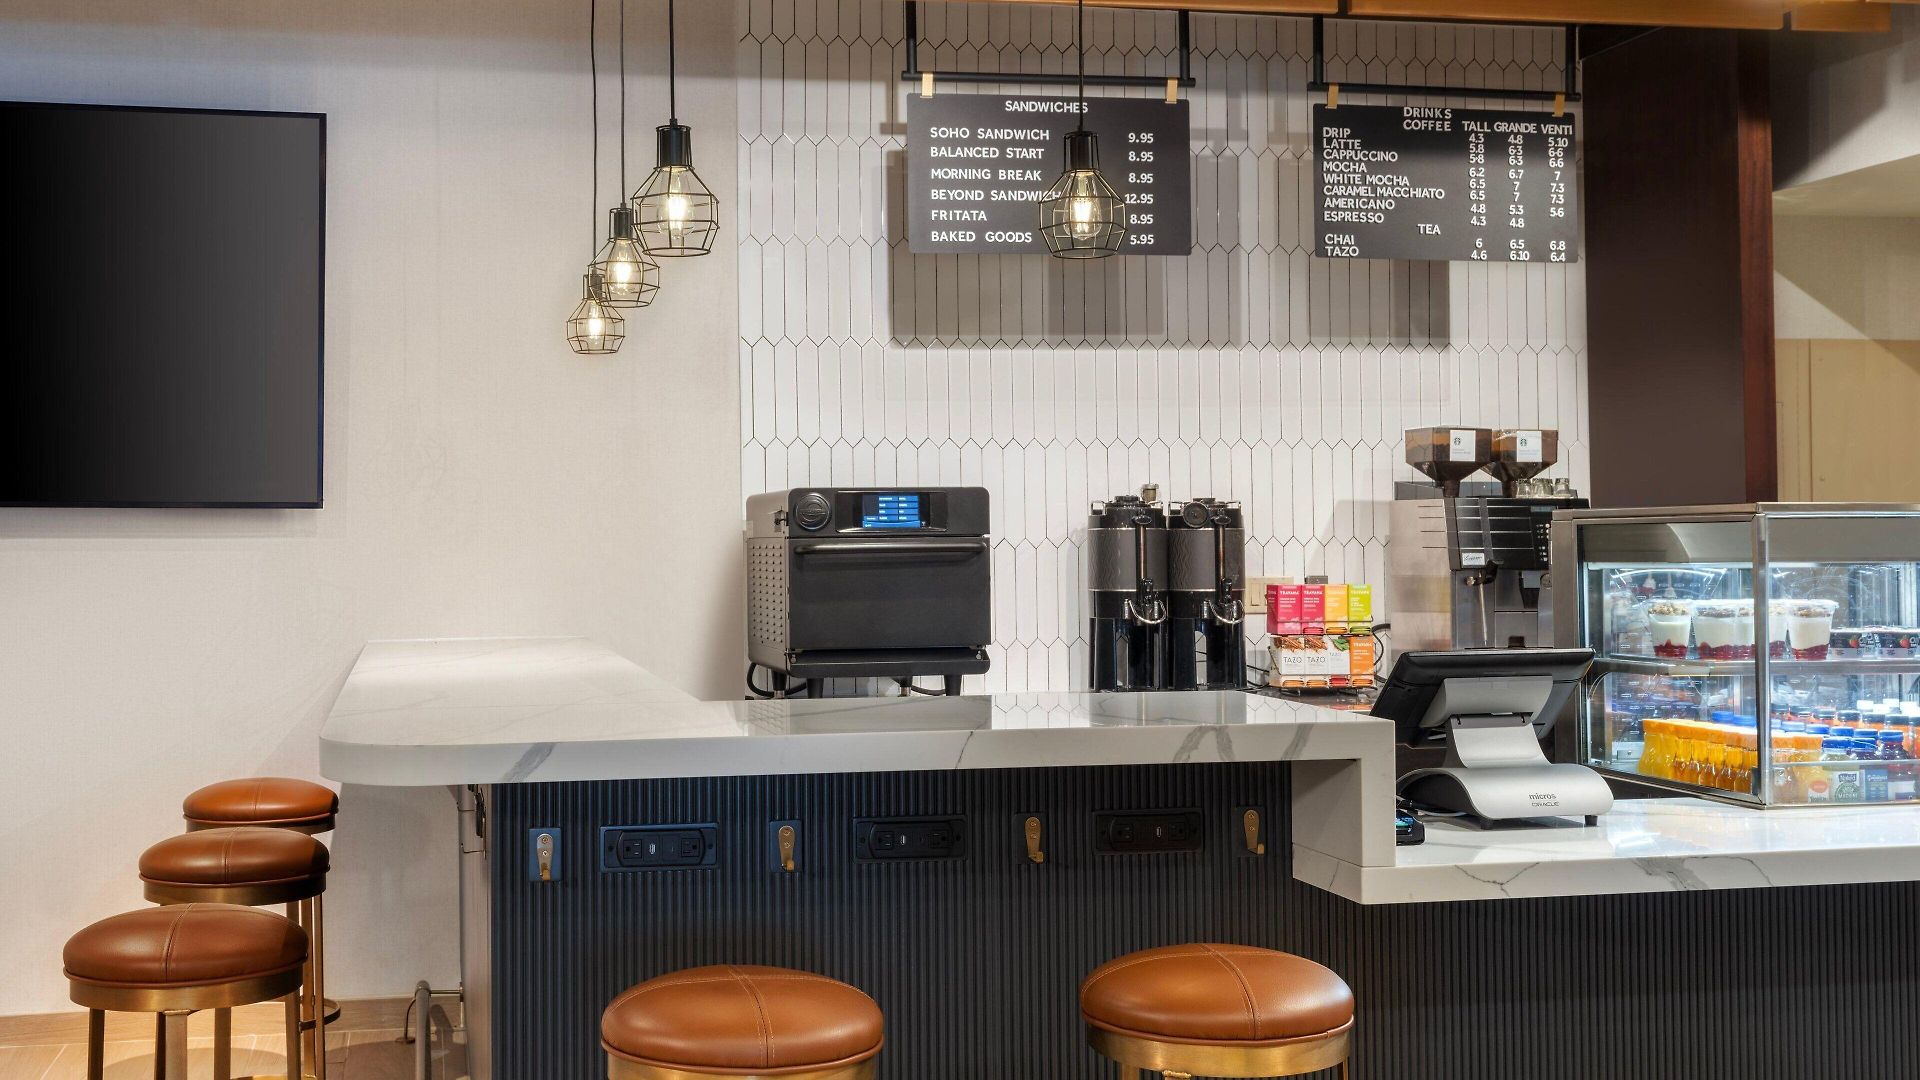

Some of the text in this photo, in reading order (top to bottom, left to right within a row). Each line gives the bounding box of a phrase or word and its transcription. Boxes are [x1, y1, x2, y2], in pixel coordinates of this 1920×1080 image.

[1005, 100, 1088, 113] SANDWICHES
[1404, 107, 1452, 118] DRINKS
[1404, 120, 1572, 135] COFFEE TALL GRANDE VENTI
[930, 127, 1154, 144] SOHO SANDWICH 9.95
[1323, 127, 1568, 147] DRIP 4.3 4.8 5.10
[1323, 139, 1361, 150] LATTE
[1470, 143, 1484, 153] 5.8
[930, 147, 1154, 162] BALANCED START 8.95
[1323, 150, 1398, 162] CAPPUCCINO
[1549, 158, 1564, 167] 6.6
[931, 168, 1154, 184] MORNING BREAK 8.95
[1323, 161, 1560, 180] MOCHA 6.2 6.7 7
[1323, 174, 1564, 192] WHITE MOCHA 6.5 7 7.3
[931, 190, 984, 201] BEYOND
[1124, 193, 1154, 204] 12.95
[1324, 185, 1564, 203] CARAMEL MACCHIATO 6.5 7 7.3
[1324, 198, 1564, 217] AMERICANO 4.8 5.3 5.6
[931, 210, 1154, 224] FRITATA 8.95
[1324, 211, 1525, 227] ESPRESSO 4.3 4.8
[1418, 223, 1441, 235] TEA
[931, 231, 1154, 245] BAKED GOODS 5.95
[1325, 234, 1565, 250] CHAI 6 6.5 6.8
[1325, 245, 1566, 262] TAZO 4.6 6.10 6.4
[1283, 656, 1302, 664] TAZO
[1307, 656, 1326, 664] TAZO
